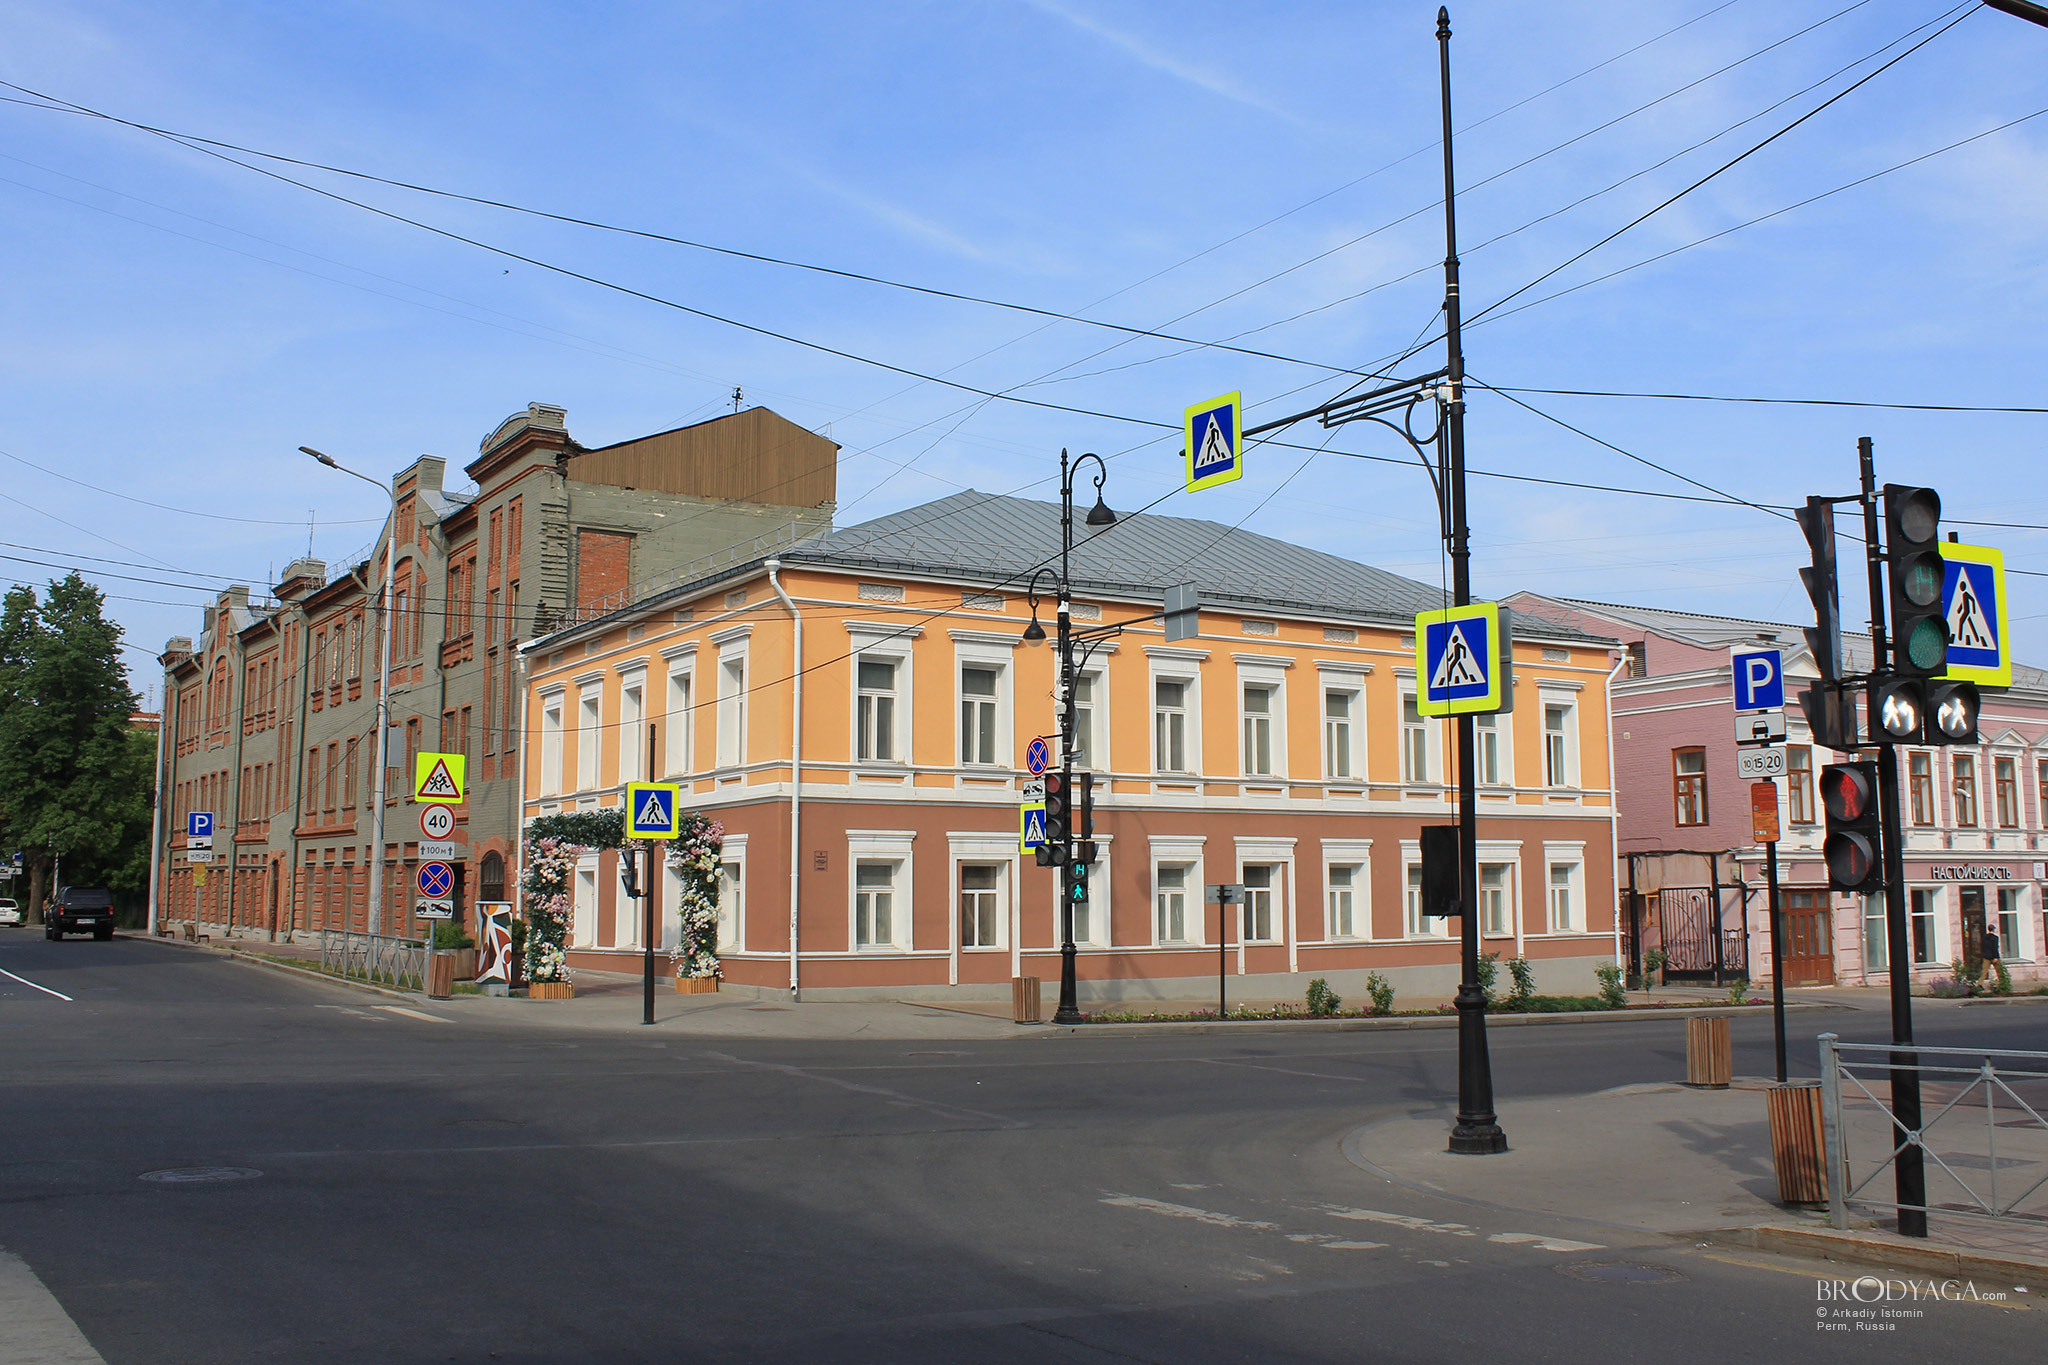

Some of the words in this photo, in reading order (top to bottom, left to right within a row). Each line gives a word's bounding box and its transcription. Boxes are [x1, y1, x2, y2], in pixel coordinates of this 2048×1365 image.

[1745, 657, 1774, 704] P
[1743, 759, 1752, 768] 10
[1753, 757, 1763, 769] 15
[1766, 755, 1781, 768] 20
[194, 815, 209, 834] P
[428, 814, 447, 829] 40
[1931, 863, 2012, 879] НАСТОЙЧИВОСТЬ
